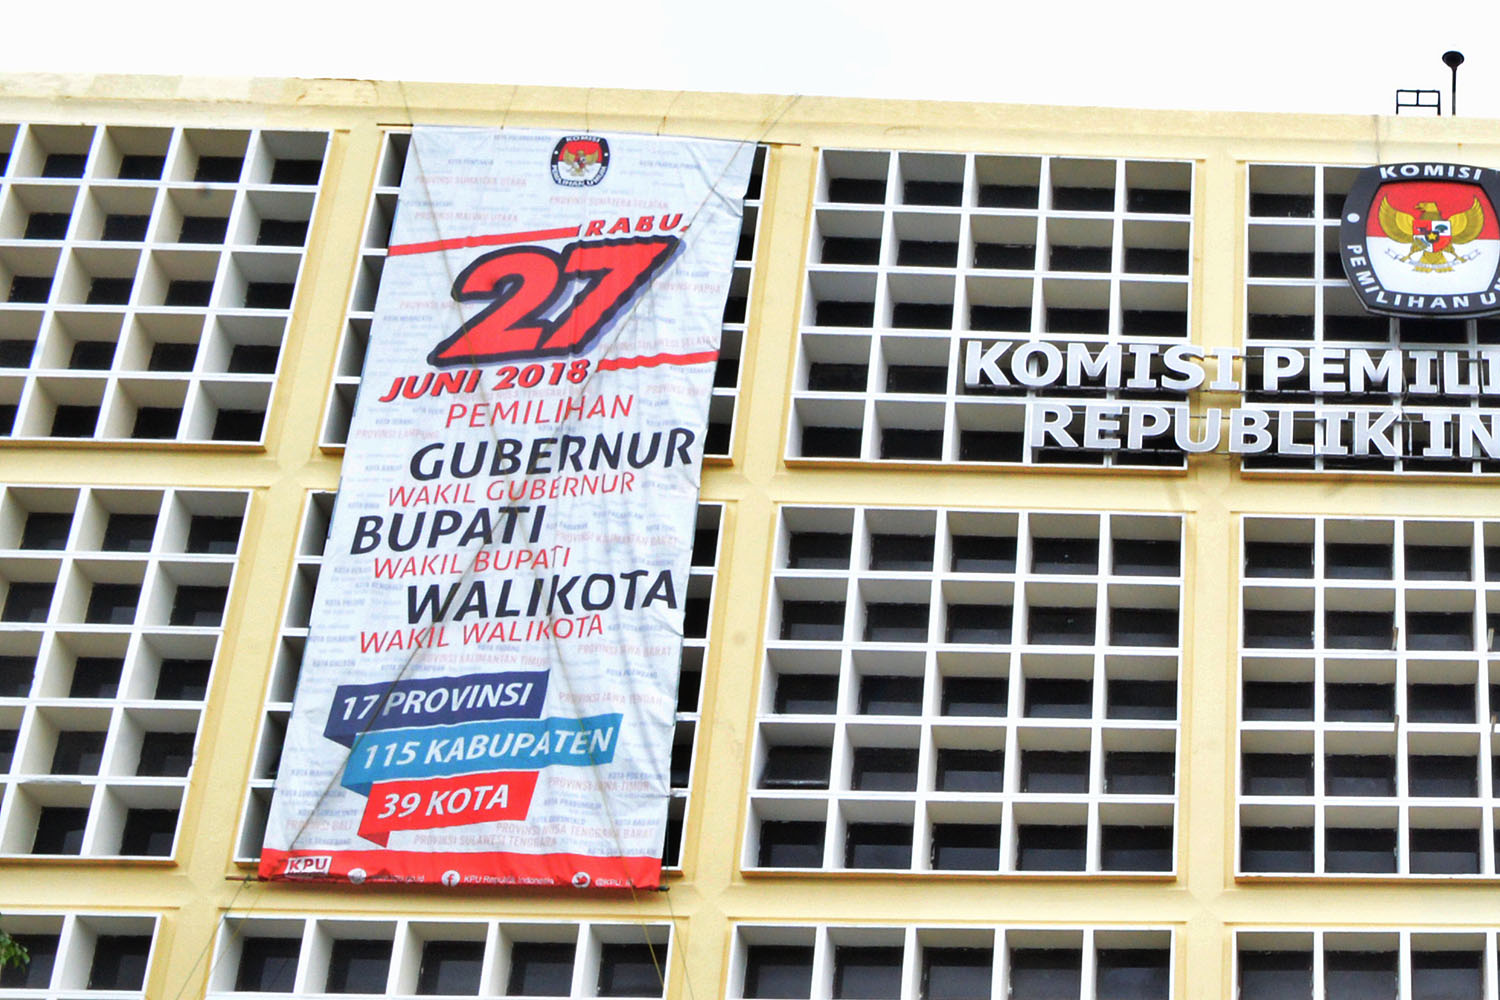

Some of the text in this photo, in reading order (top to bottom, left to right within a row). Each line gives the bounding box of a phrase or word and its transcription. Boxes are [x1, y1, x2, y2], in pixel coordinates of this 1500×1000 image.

[1379, 164, 1482, 181] KOMISI
[1347, 244, 1470, 309] PEMILIHAN
[427, 235, 684, 367] 27
[378, 358, 590, 402] JUNI 2018
[965, 341, 1242, 391] KOMISI
[445, 395, 633, 430] PEMILIHAN
[1031, 404, 1403, 457] REPUBLIK
[409, 428, 696, 482] GUBERNUR
[388, 472, 635, 508] WAKIL GUBERNUR
[350, 505, 547, 556] BUPATI
[374, 545, 570, 580] WAKIL BUPATI
[407, 570, 679, 624] WALIKOTA
[360, 614, 603, 653] WAKIL WALIKOTA
[343, 682, 533, 721] 17 PROVINSI
[365, 726, 613, 770] 115 KABUPATEN
[378, 784, 509, 819] 39 KOTA
[289, 858, 328, 871] KPU
